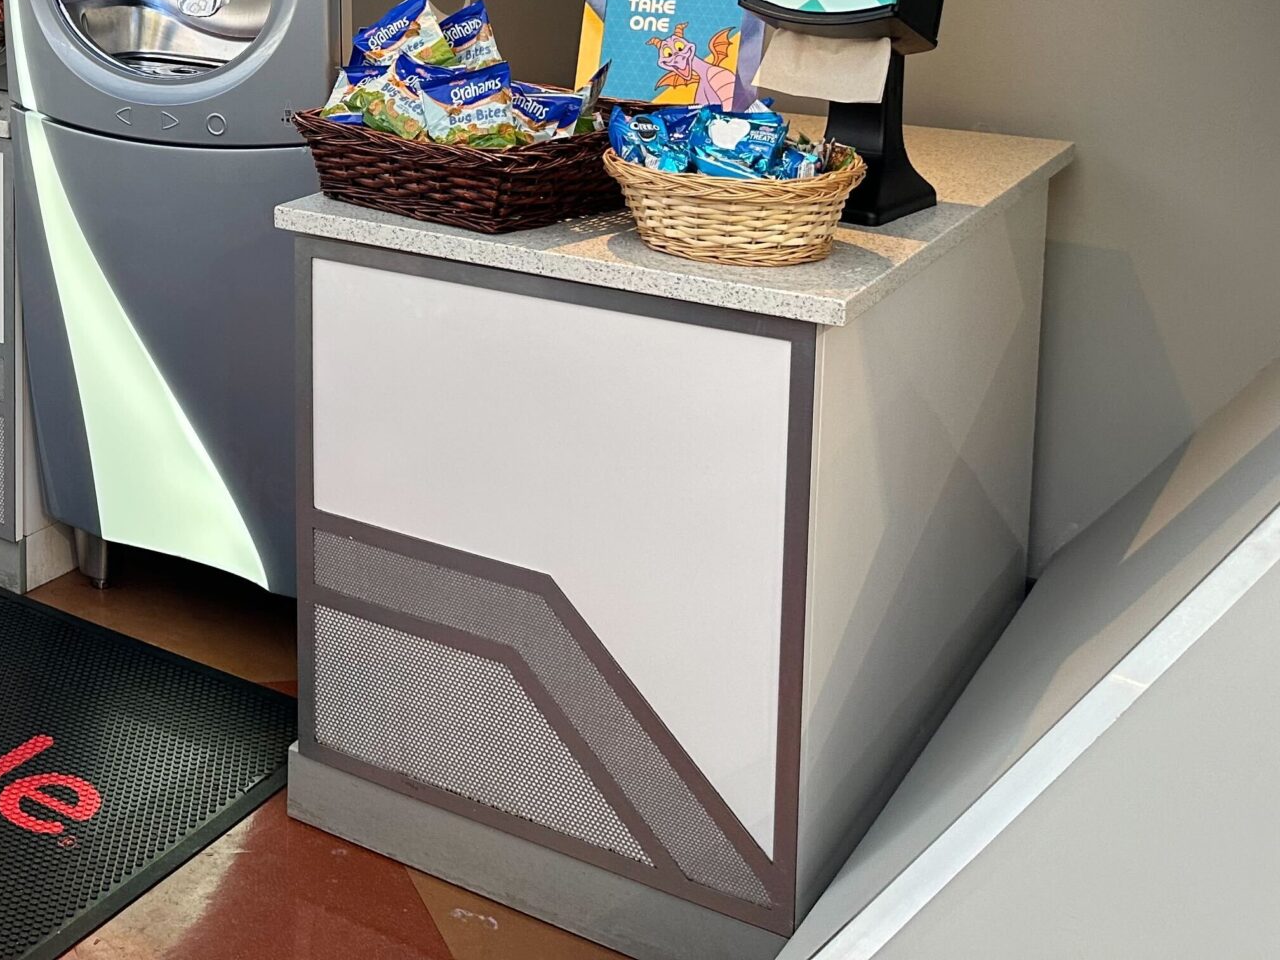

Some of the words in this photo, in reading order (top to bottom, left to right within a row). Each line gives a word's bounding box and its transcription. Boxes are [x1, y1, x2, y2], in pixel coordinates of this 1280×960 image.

[367, 16, 411, 51] grahams
[629, 16, 670, 33] ONE
[465, 44, 492, 60] Bites
[450, 77, 502, 107] grahams
[449, 113, 472, 126] Bug
[475, 107, 507, 121] Bites
[630, 121, 660, 131] OREO
